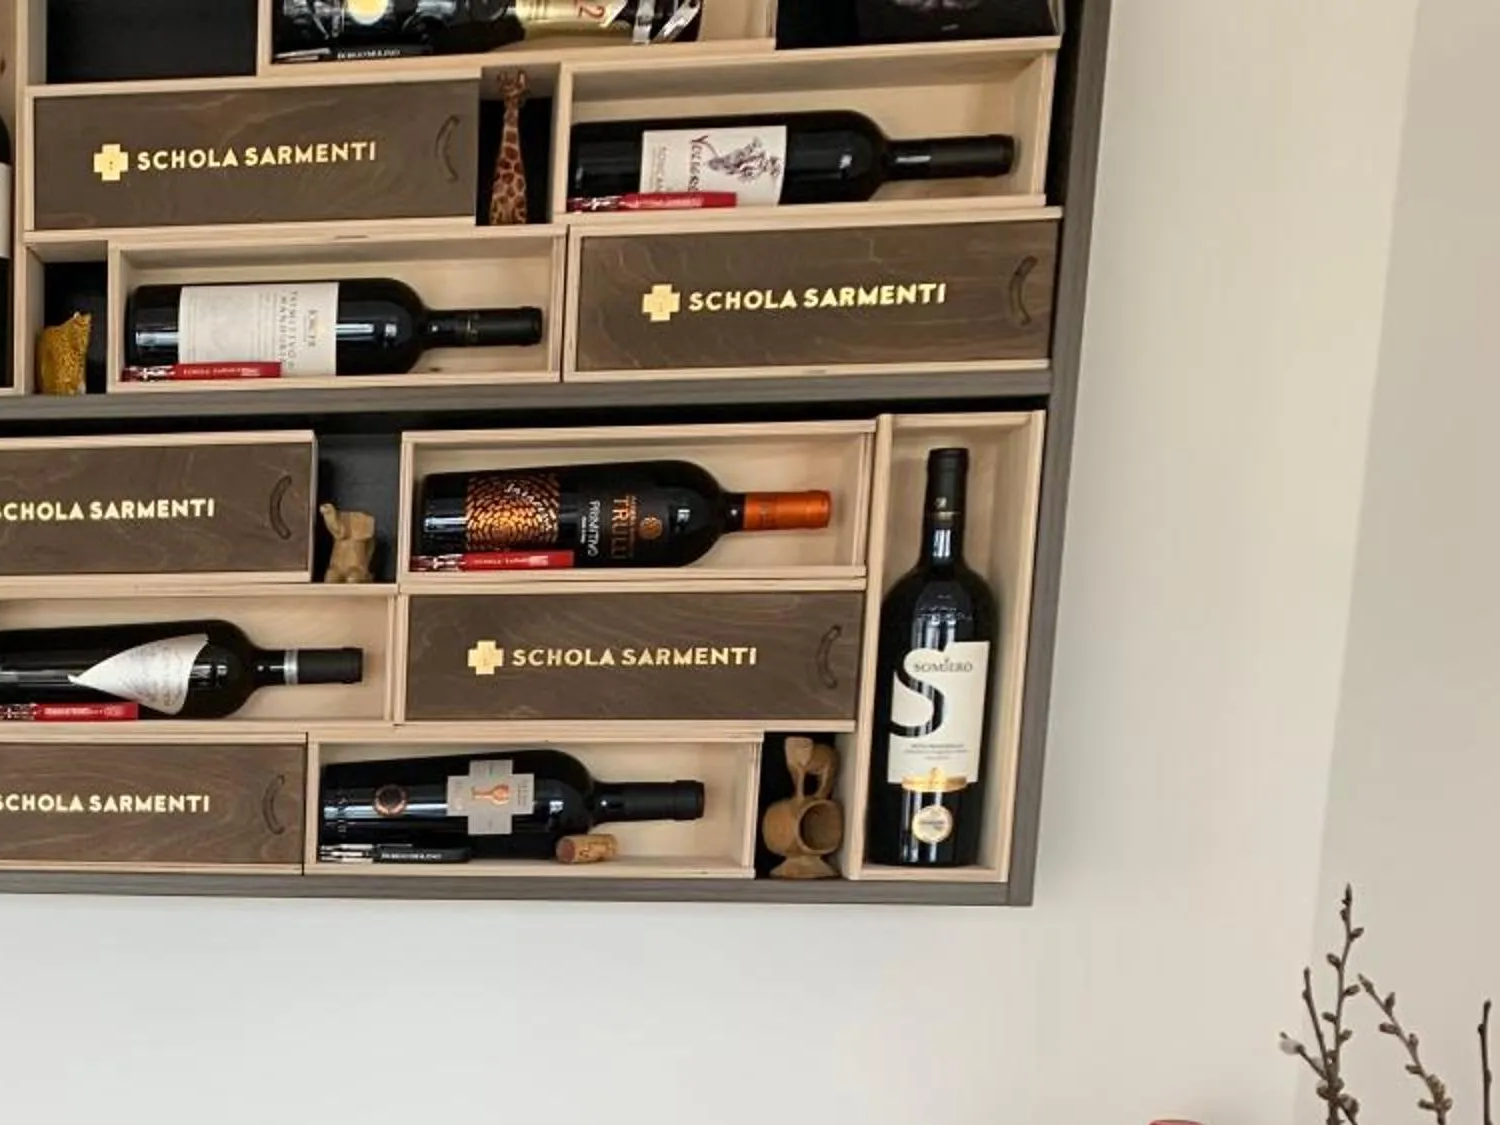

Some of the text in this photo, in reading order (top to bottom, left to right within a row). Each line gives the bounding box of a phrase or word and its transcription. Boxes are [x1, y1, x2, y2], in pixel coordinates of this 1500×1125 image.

[137, 141, 378, 171] SCHOLA SARMENTI
[688, 283, 947, 313] SCHOLA SARMENTI
[89, 497, 216, 520] SARMENTI
[610, 495, 629, 560] TRULLI
[511, 646, 758, 667] SCHOLA SARMENTI
[89, 794, 211, 813] SARMENTI
